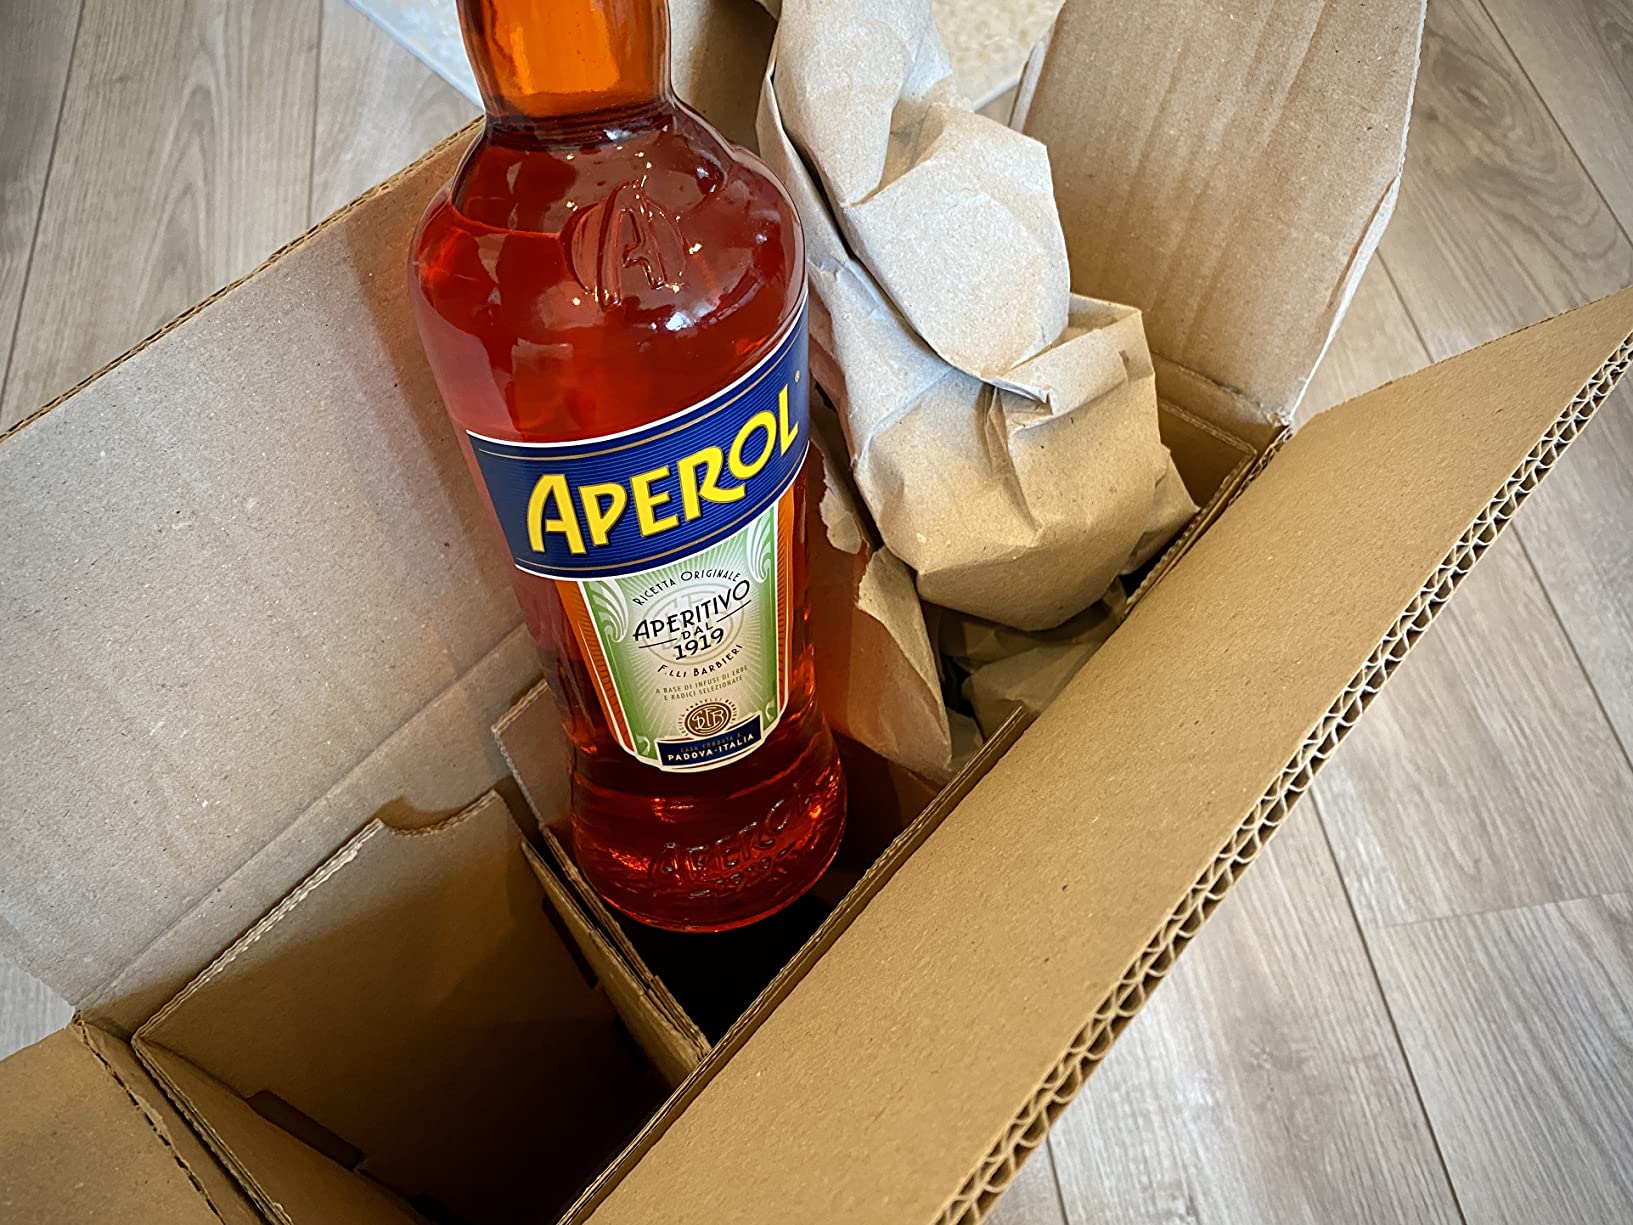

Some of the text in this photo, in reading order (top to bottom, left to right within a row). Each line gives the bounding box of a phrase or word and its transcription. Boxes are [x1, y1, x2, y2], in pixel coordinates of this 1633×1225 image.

[526, 388, 800, 555] APEROL
[632, 569, 741, 606] RICETTA ORIGINALE
[632, 579, 750, 641] APERITIVO
[673, 627, 724, 660] 1919
[681, 622, 713, 640] DAL
[693, 644, 743, 677] BARBIERI
[663, 685, 681, 693] BASE
[695, 677, 720, 688] INFUSI
[721, 673, 730, 681] DI
[671, 691, 697, 700] RADICI
[699, 675, 743, 694] SELEZIONATE
